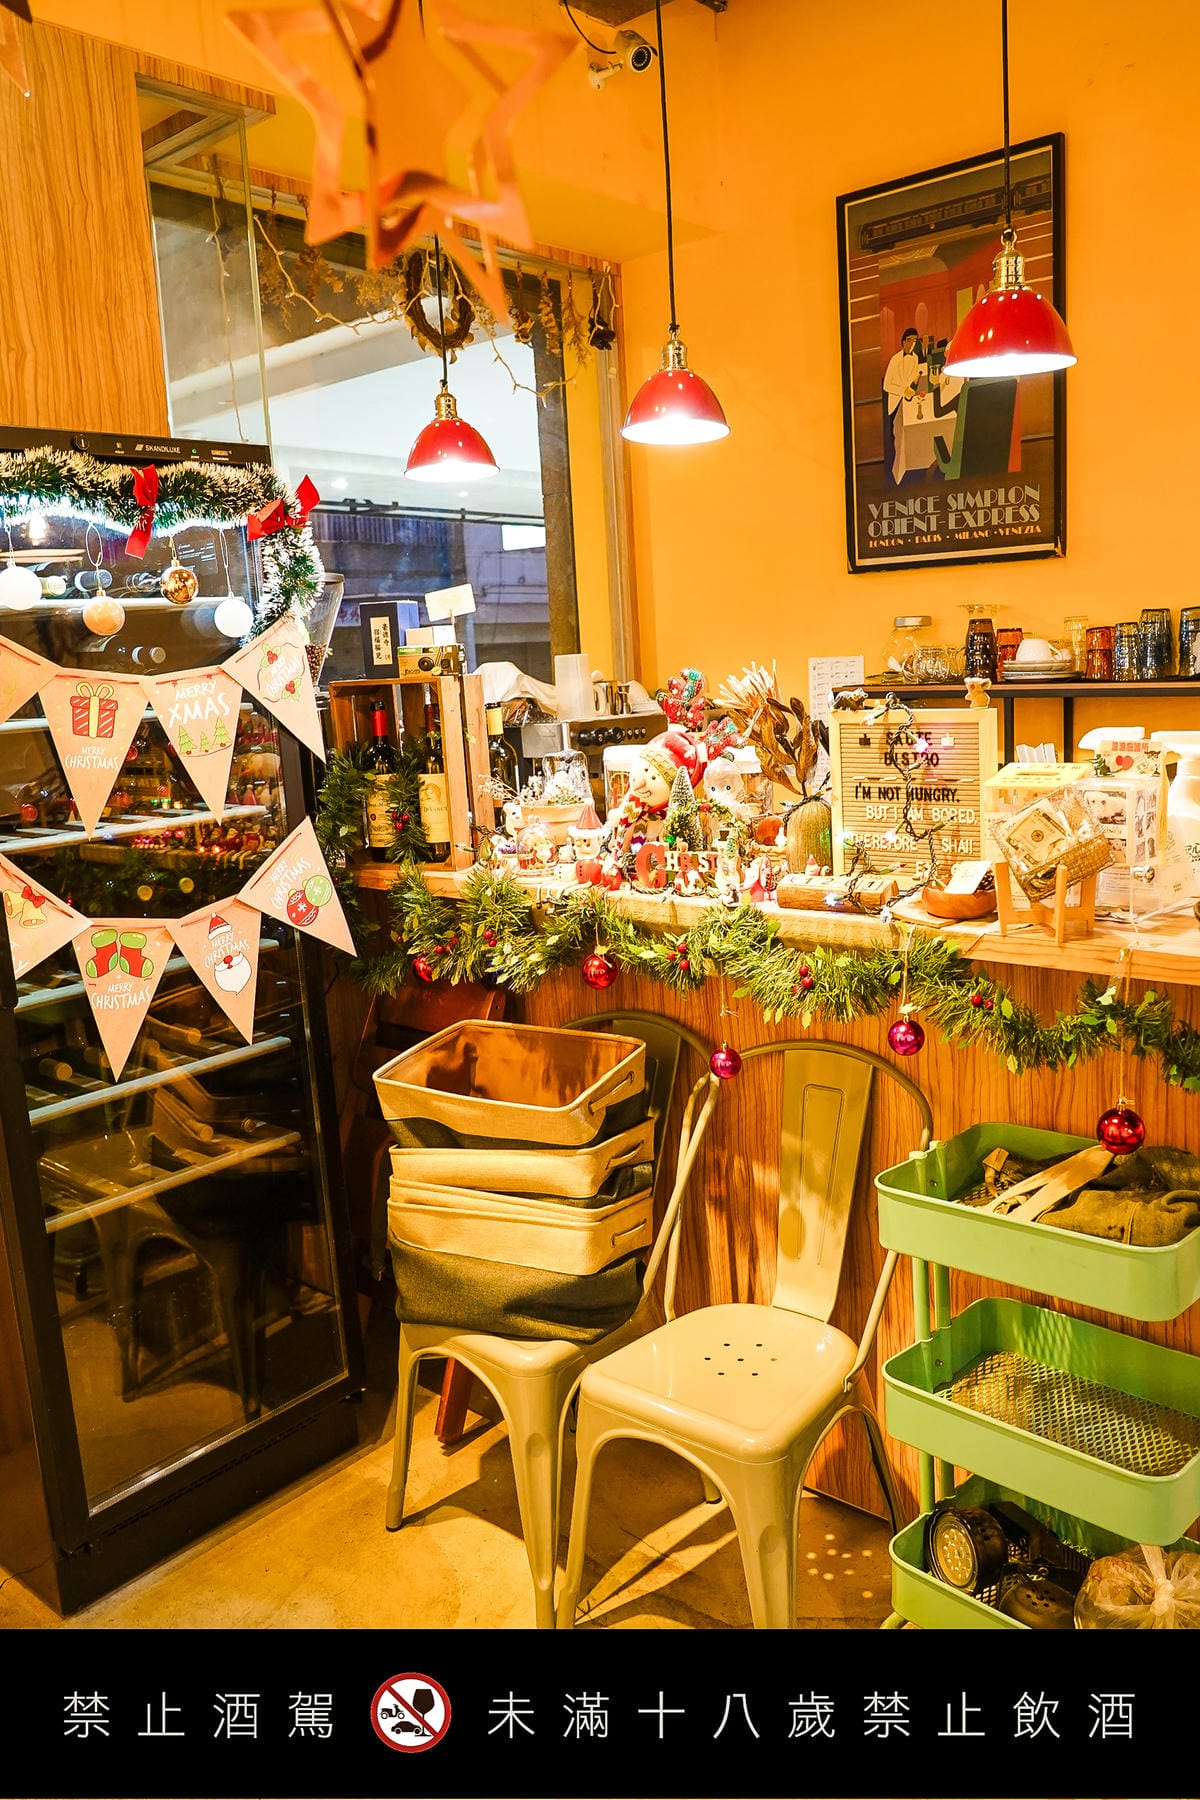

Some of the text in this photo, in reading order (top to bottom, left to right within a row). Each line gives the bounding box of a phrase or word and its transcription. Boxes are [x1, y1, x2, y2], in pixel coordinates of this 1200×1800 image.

[145, 444, 181, 454] SKANDILUXE
[868, 484, 1040, 520] VENICE SIMPLON
[868, 504, 1040, 538] ORIENT-EXPRESS
[869, 525, 1042, 548] LONDON PARIS MILANO VENEZIA
[175, 680, 217, 701] MERRY
[167, 692, 231, 729] XMAS
[81, 745, 106, 755] MERRY
[65, 754, 119, 770] CHRISTMAS
[855, 782, 872, 799] I'M
[878, 786, 901, 800] NOT
[866, 805, 888, 820] BUT
[907, 807, 924, 821] AM
[204, 939, 250, 969] CHRISTMAS
[91, 985, 151, 1010] CHRISTMAS
[107, 981, 134, 994] MERRY
